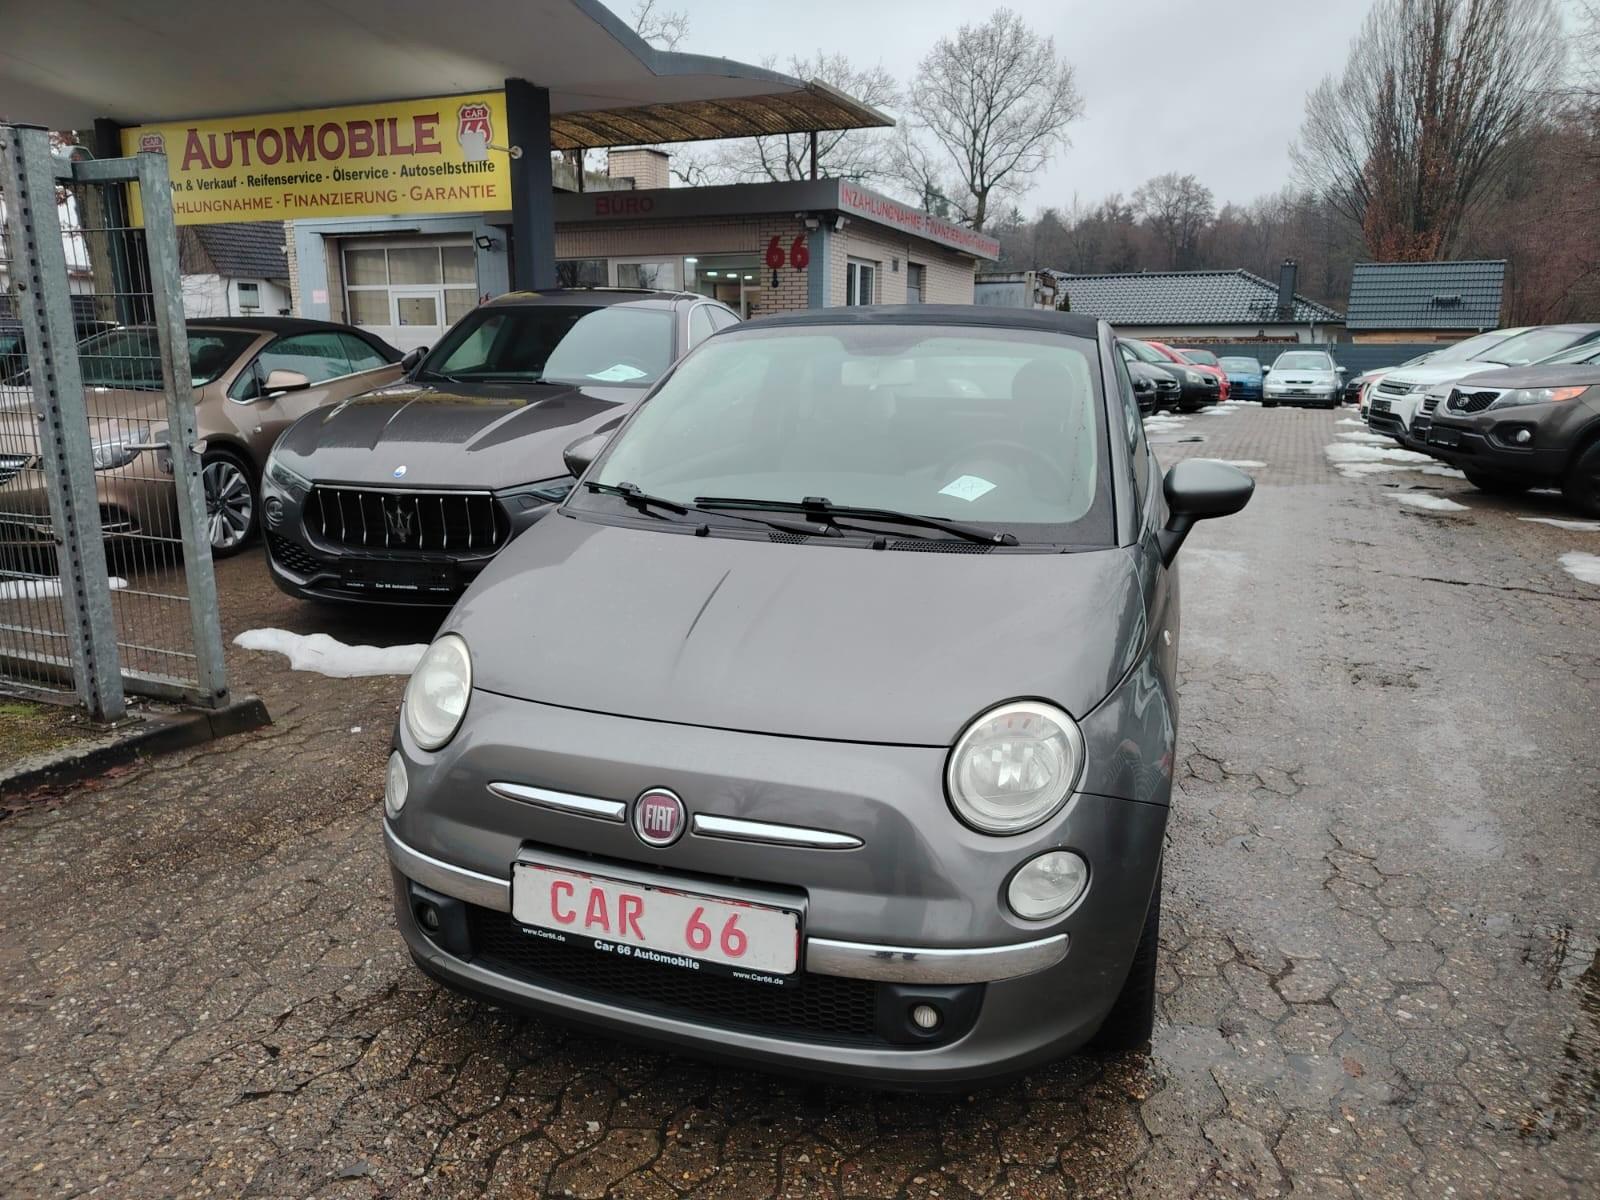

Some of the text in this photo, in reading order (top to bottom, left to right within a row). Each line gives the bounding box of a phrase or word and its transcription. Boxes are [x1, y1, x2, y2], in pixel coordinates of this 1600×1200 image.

[464, 109, 485, 118] CAR
[181, 112, 441, 171] AUTOMOBILE
[186, 180, 193, 191] &
[196, 176, 237, 191] Verkauf
[247, 171, 322, 188] Reifenservice
[333, 166, 389, 182] Ölservice
[400, 160, 495, 178] Autoselbsthilfe
[284, 190, 397, 208] FINANZIERUNG
[410, 184, 496, 201] GARANTIE
[767, 233, 809, 270] 66
[645, 804, 675, 832] FIAT
[550, 880, 748, 958] CAR 66
[594, 939, 700, 970] Car 66 Automobile
[733, 971, 784, 985] www.Car66.de
